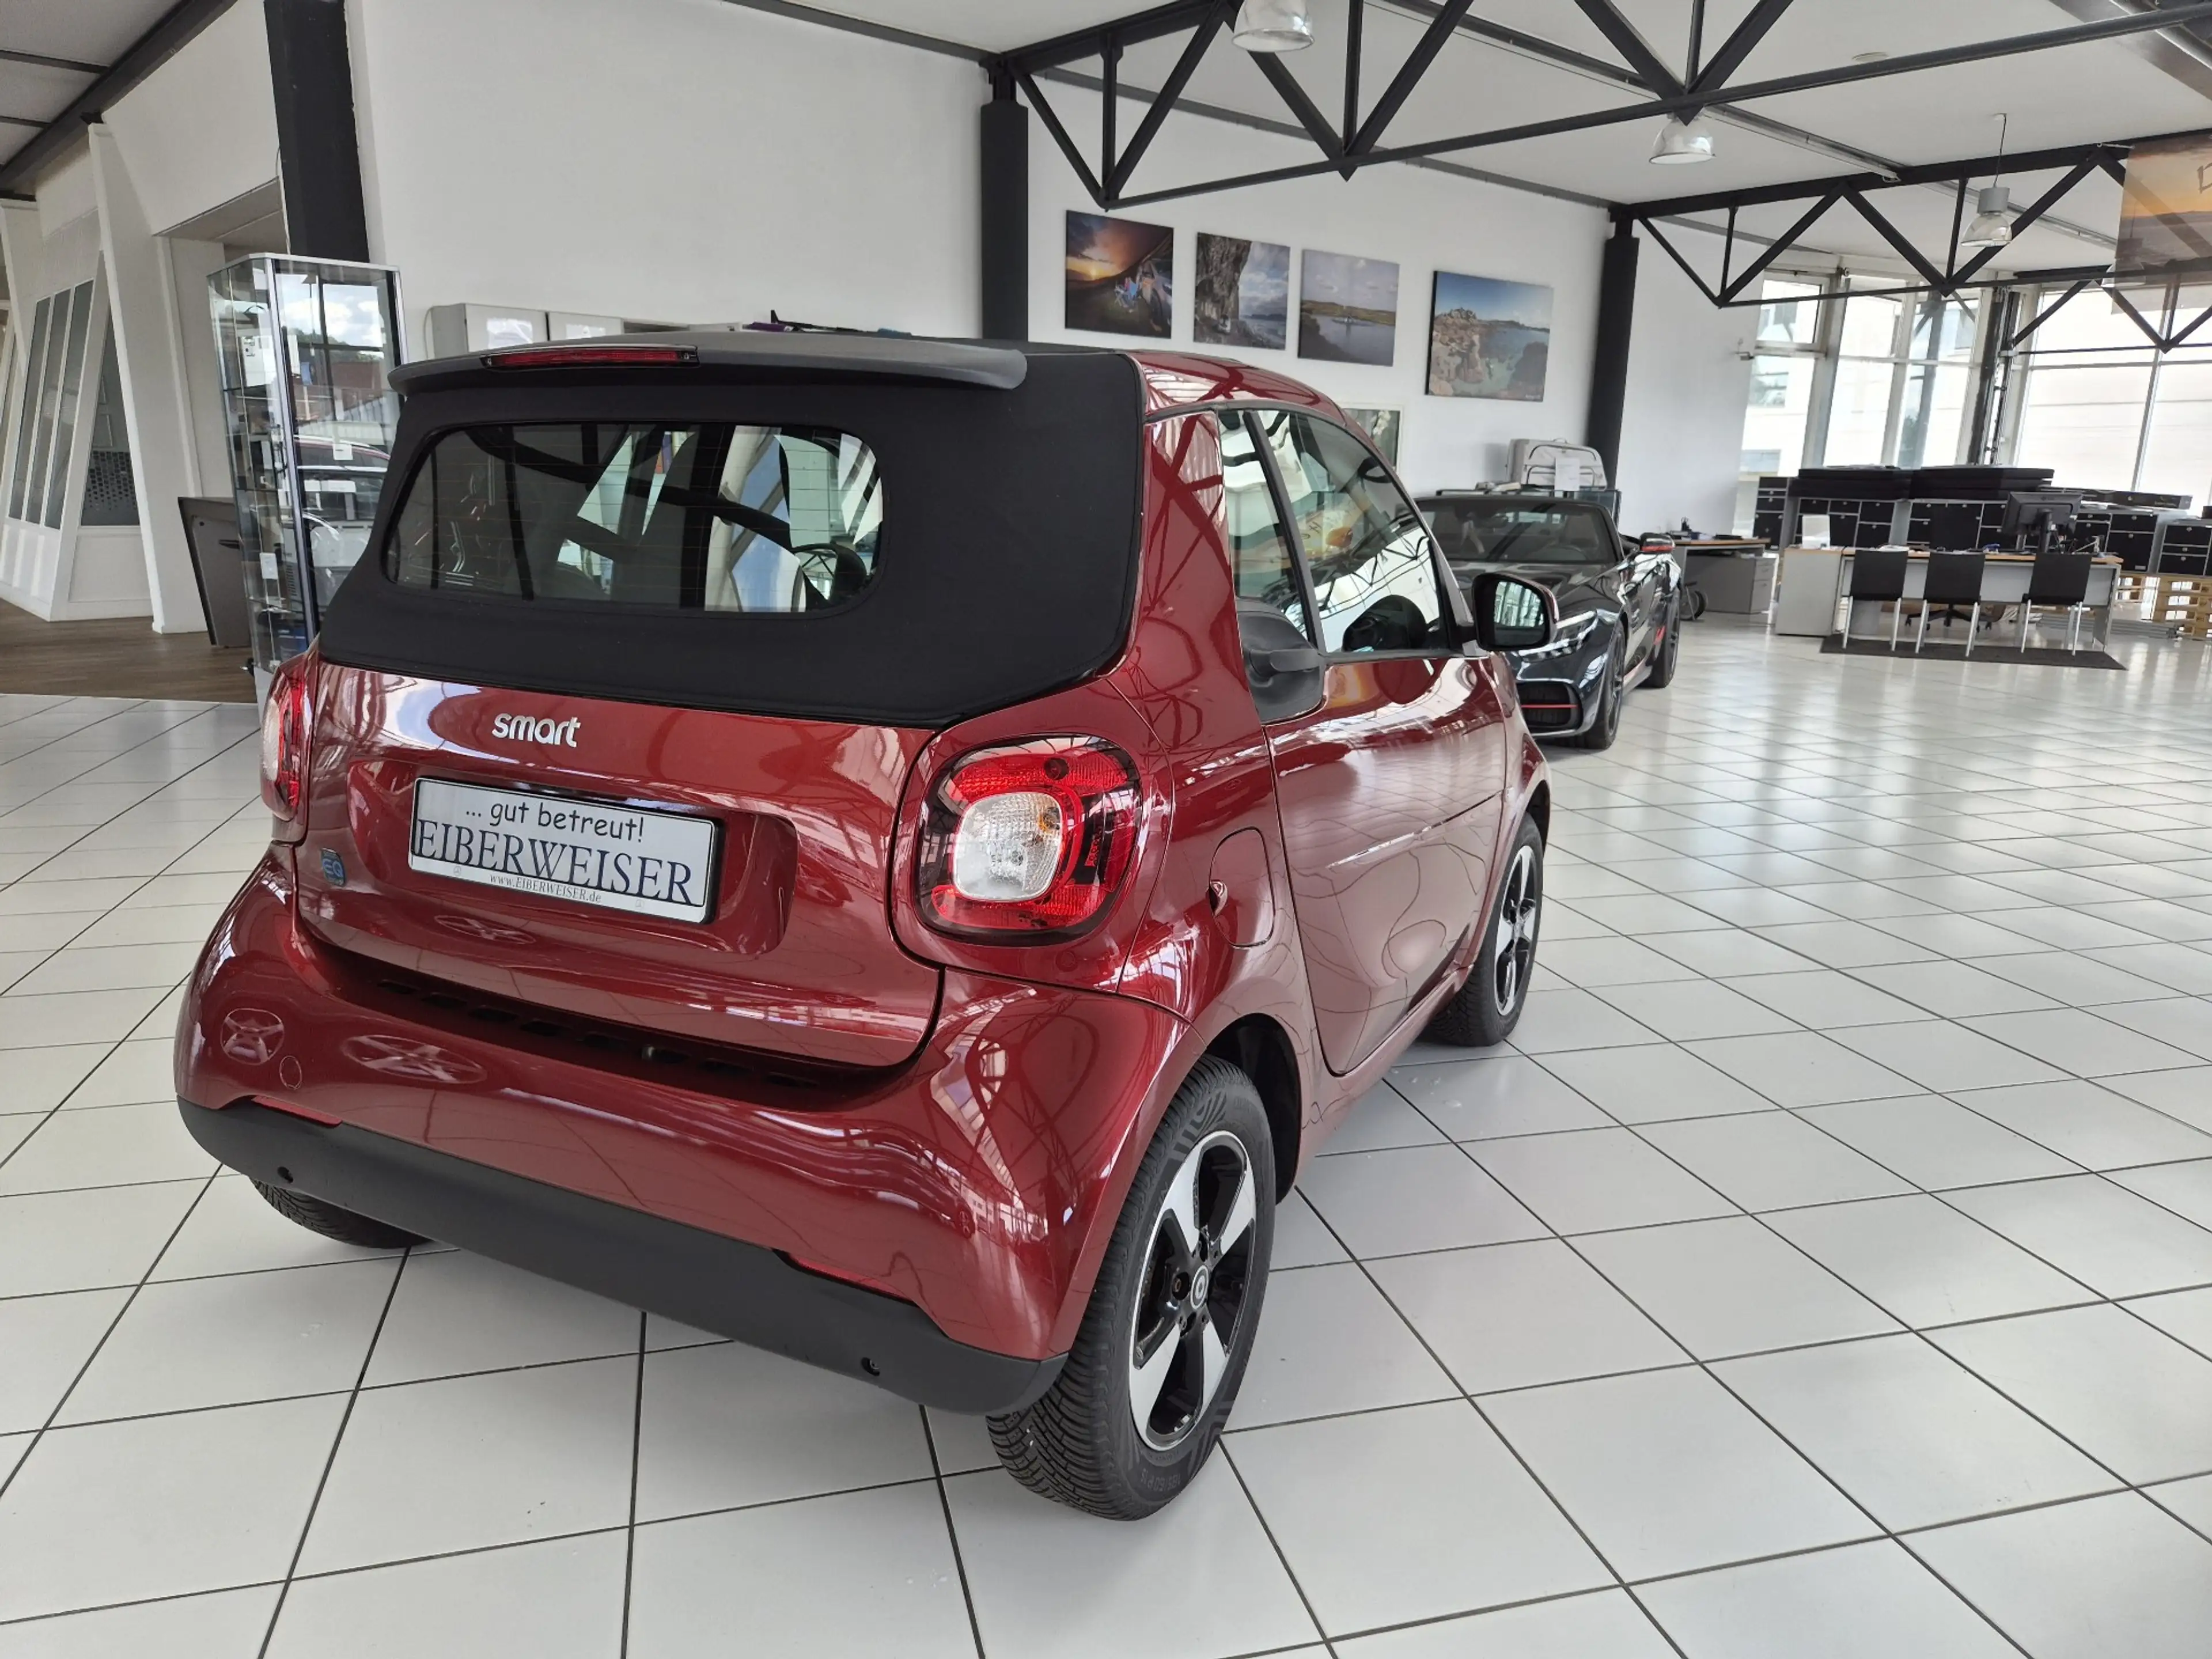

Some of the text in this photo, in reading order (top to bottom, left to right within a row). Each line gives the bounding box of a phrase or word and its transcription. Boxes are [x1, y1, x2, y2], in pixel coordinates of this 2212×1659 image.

[492, 713, 581, 748] smart
[490, 802, 529, 827] gut
[537, 802, 644, 843] betreut!
[322, 858, 344, 878] EQ
[418, 819, 691, 904] EIBERWEISER
[490, 874, 602, 903] www.EIBERWEISER.de
